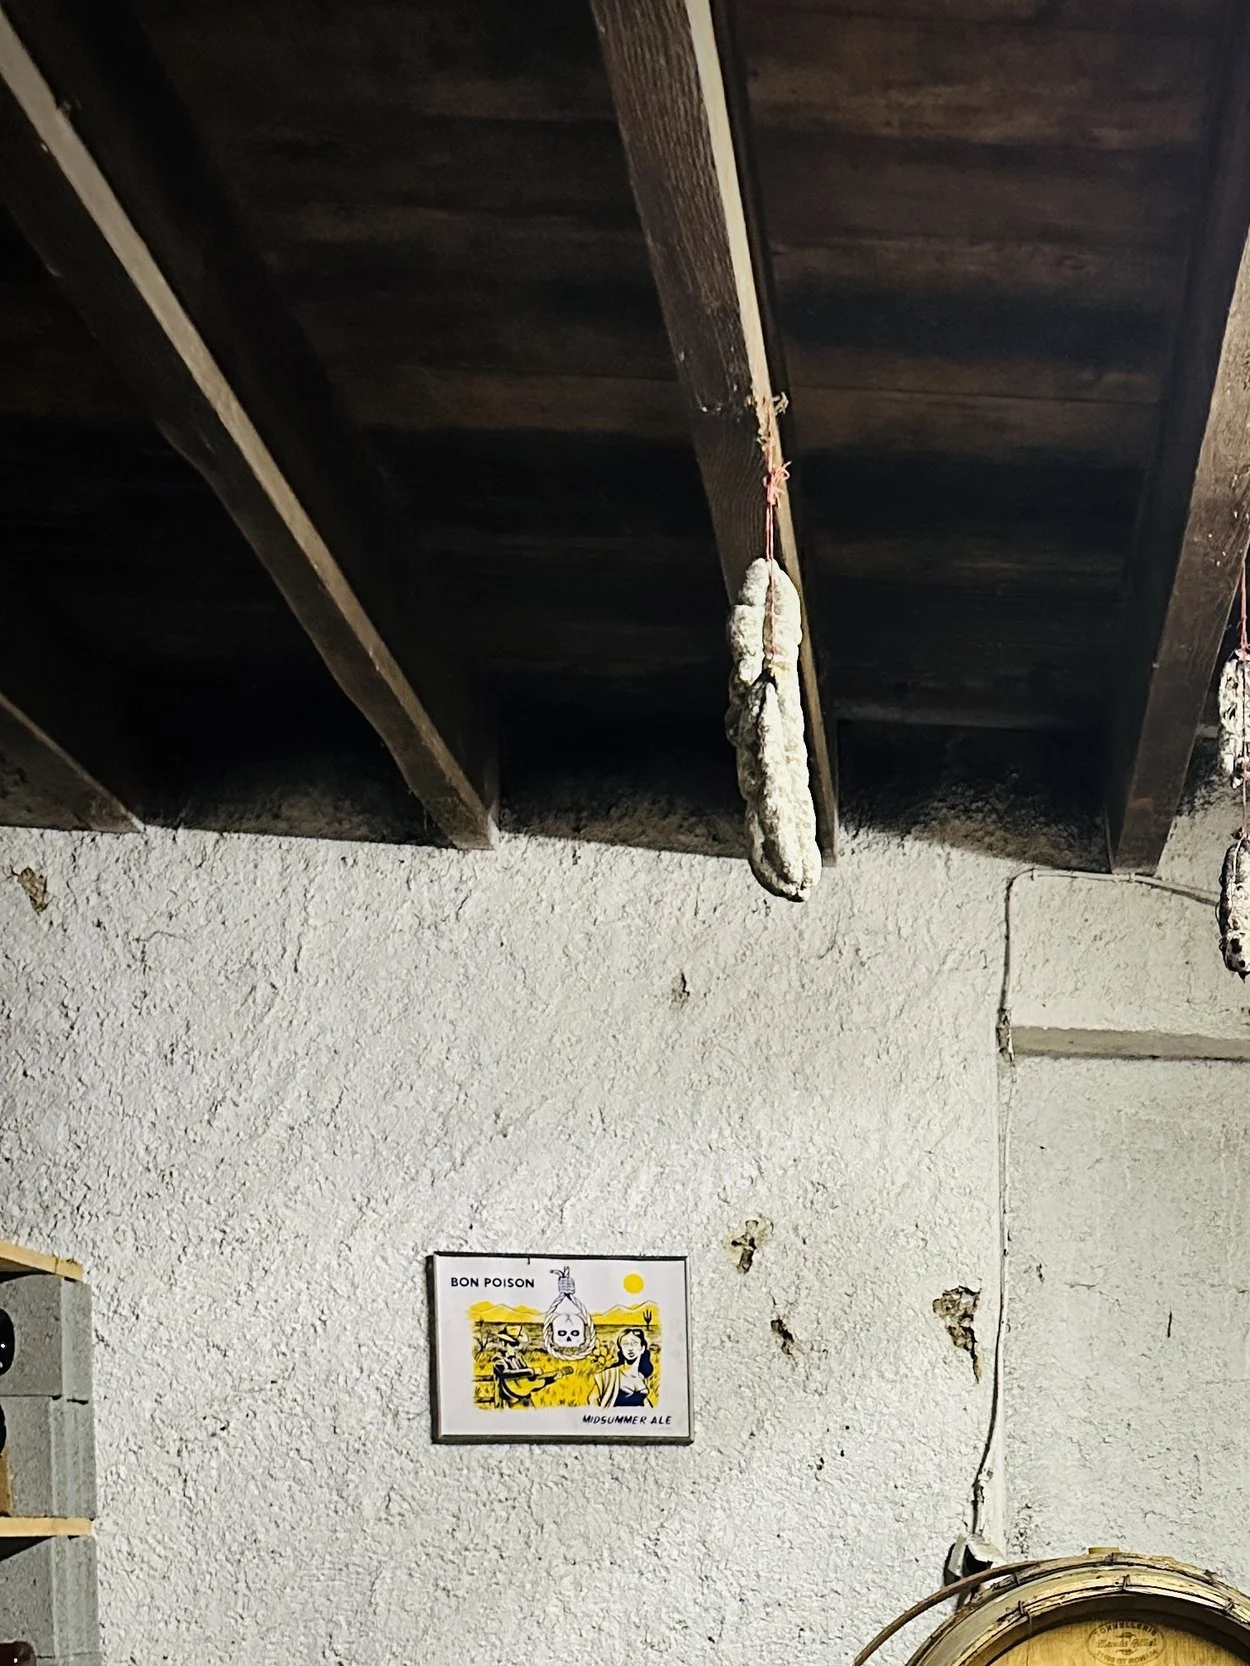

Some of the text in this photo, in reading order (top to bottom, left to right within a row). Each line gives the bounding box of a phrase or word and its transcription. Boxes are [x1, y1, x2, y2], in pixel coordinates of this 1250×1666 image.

[450, 1276, 535, 1289] BON POISON
[582, 1414, 672, 1425] MIDSUMMER ALE
